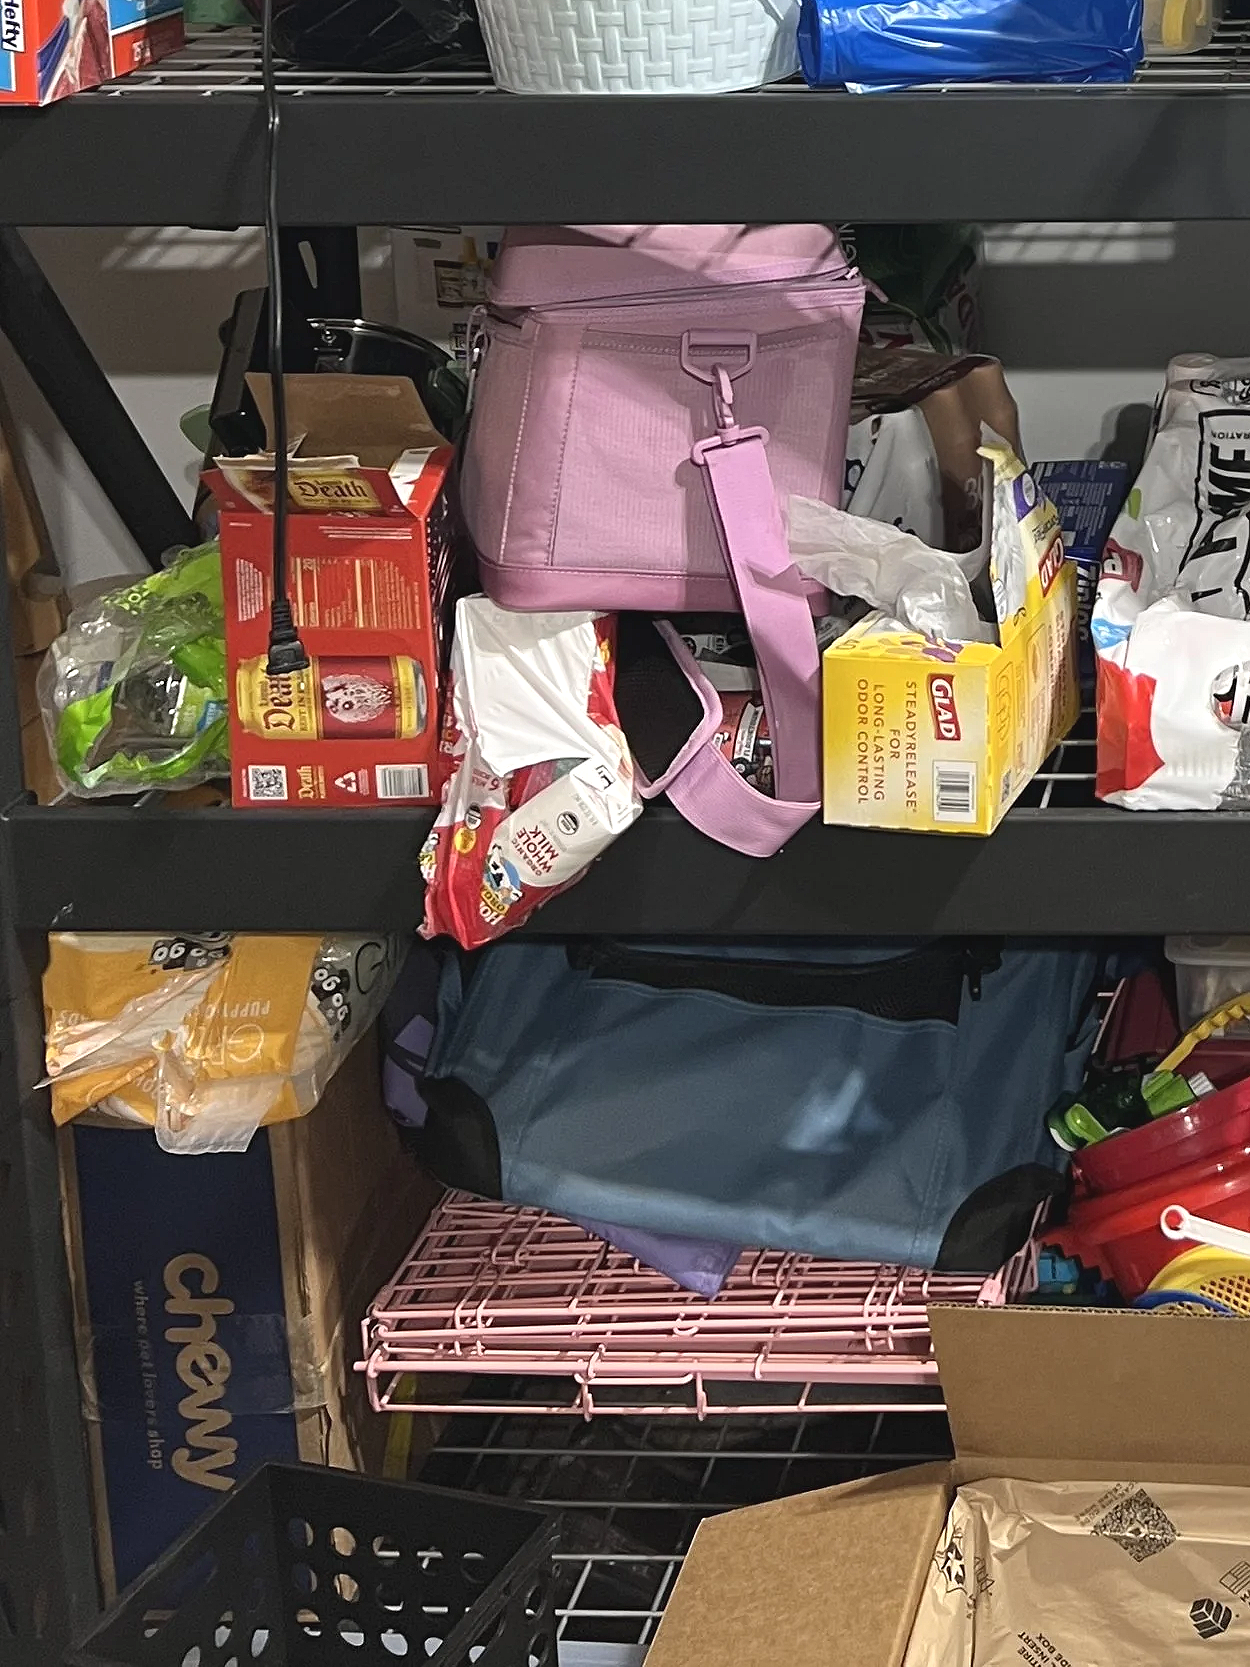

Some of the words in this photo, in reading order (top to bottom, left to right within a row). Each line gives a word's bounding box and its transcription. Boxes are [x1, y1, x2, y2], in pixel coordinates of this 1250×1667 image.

[296, 480, 367, 497] Death
[264, 669, 295, 730] Deat
[857, 678, 869, 724] ODOR
[930, 677, 957, 739] GLAD
[873, 684, 885, 801] LONG-LASTING
[889, 729, 901, 760] FOR
[857, 732, 869, 804] CONTROL
[516, 827, 553, 875] WHOLE
[529, 824, 560, 861] MILK
[132, 1280, 152, 1332] where
[144, 1429, 167, 1470] shop
[163, 1252, 239, 1491] chewy
[1018, 1632, 1048, 1663] INSERT
[1036, 1633, 1056, 1654] BOX
